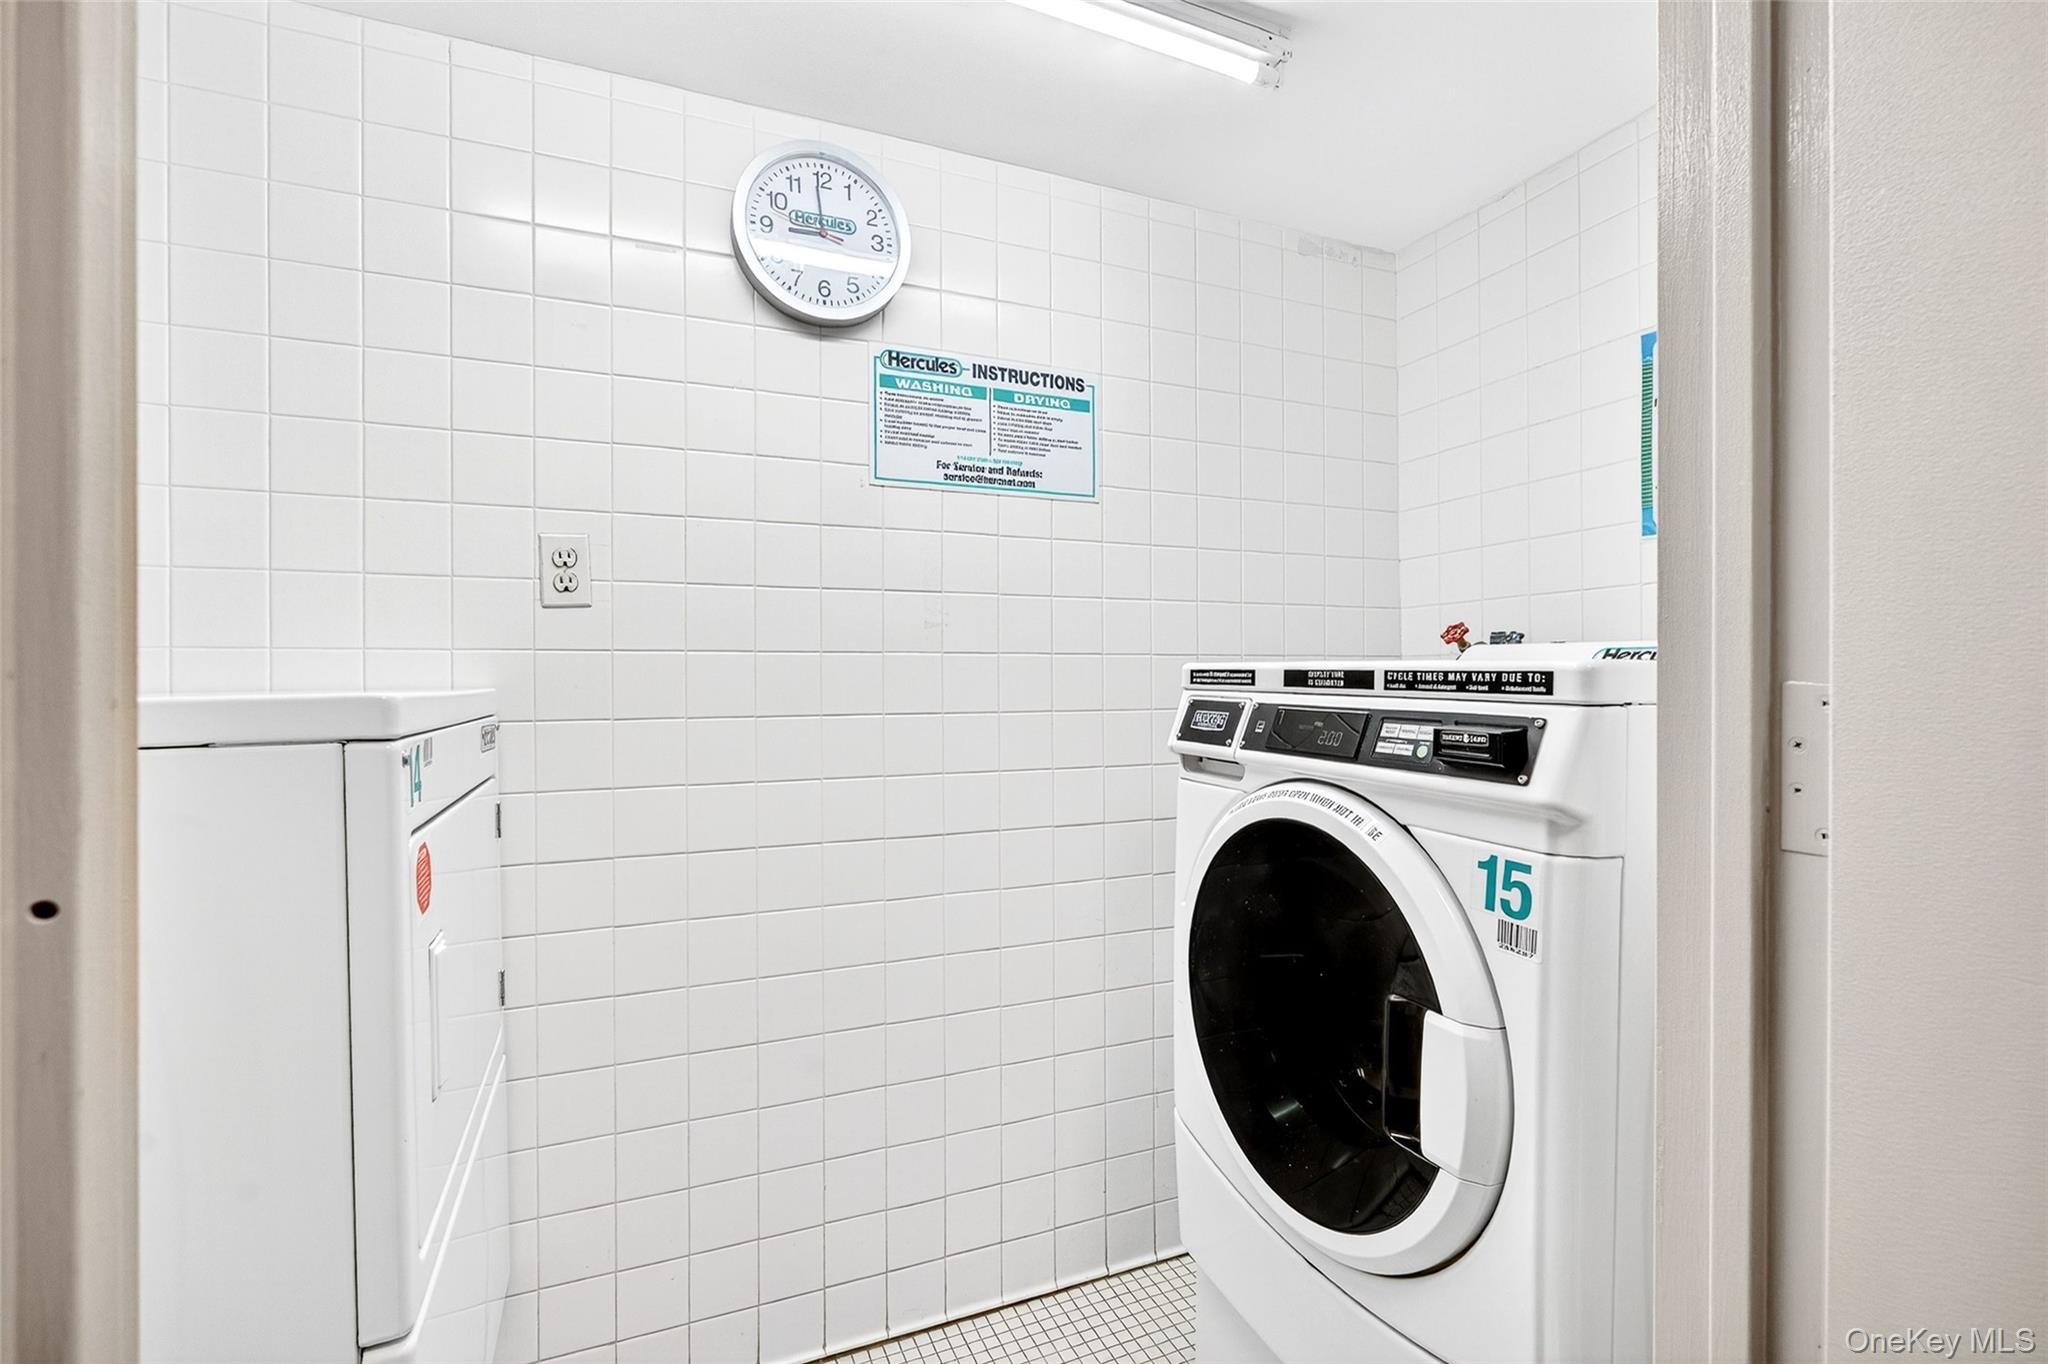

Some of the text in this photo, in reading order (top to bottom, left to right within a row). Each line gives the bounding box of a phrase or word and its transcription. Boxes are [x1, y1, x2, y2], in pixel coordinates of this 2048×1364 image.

[786, 174, 801, 194] 11
[813, 171, 833, 190] 12
[766, 191, 788, 211] 10
[843, 184, 852, 201] 1
[759, 215, 774, 234] 9
[794, 210, 852, 231] Hercules
[866, 209, 878, 227] 2
[871, 234, 884, 252] 3
[791, 268, 804, 287] 7
[846, 276, 860, 294] 5
[817, 279, 831, 298] 6
[887, 350, 1086, 393] Hercules INSTRUCTIONS
[894, 377, 974, 397] WASHING
[1013, 393, 1071, 409] DRYING
[936, 459, 952, 469] For
[988, 466, 1004, 475] and
[1387, 672, 1546, 683] CYCLE TIMES MAY VARY DUE TO:
[410, 745, 421, 807] 14
[1333, 803, 1354, 819] NOT
[1478, 855, 1533, 921] 15
